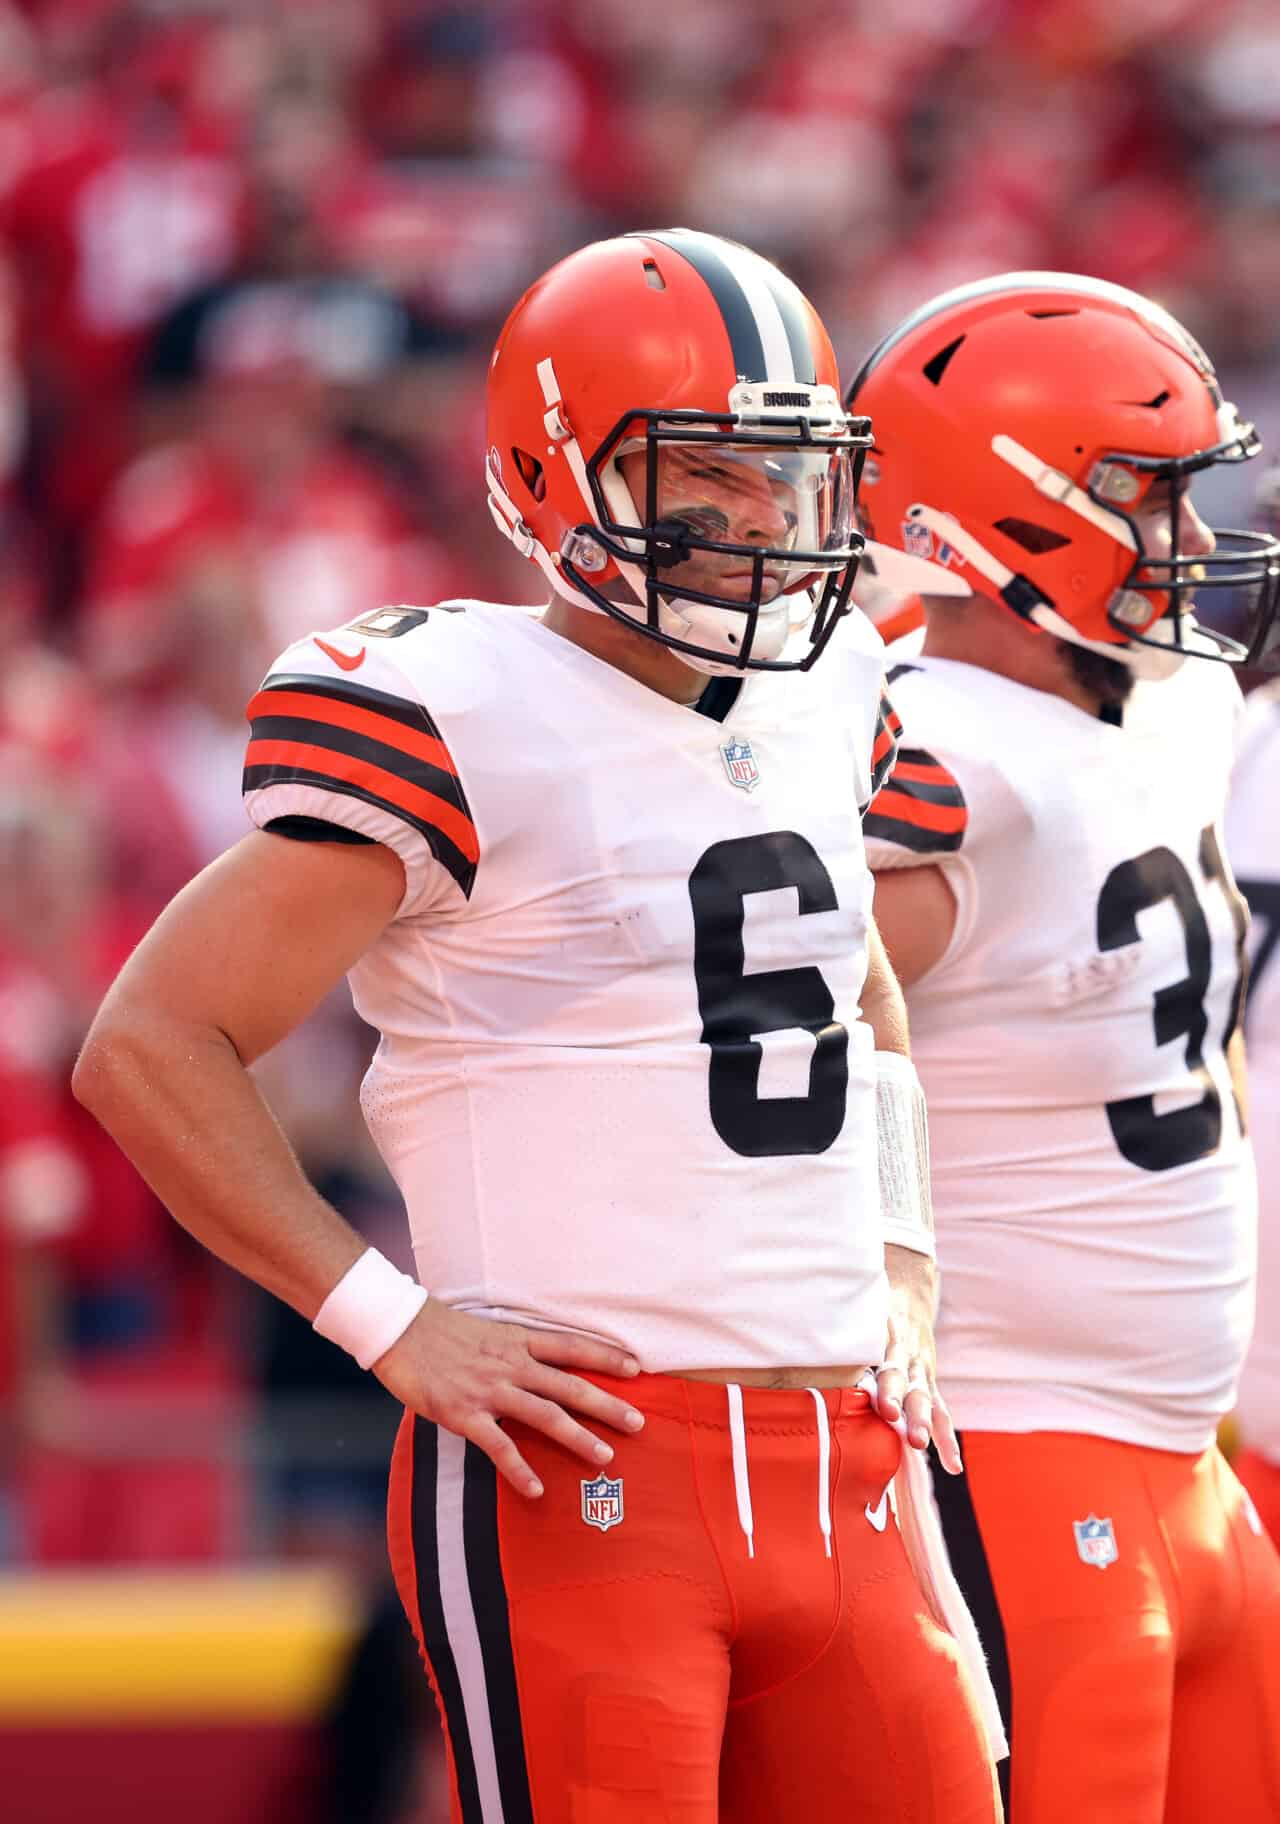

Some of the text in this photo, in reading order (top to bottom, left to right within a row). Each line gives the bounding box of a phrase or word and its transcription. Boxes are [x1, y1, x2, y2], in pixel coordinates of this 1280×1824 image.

[763, 392, 811, 407] BROWNS
[732, 760, 757, 780] NFL
[688, 830, 849, 1157] 6
[589, 1500, 618, 1520] NFL
